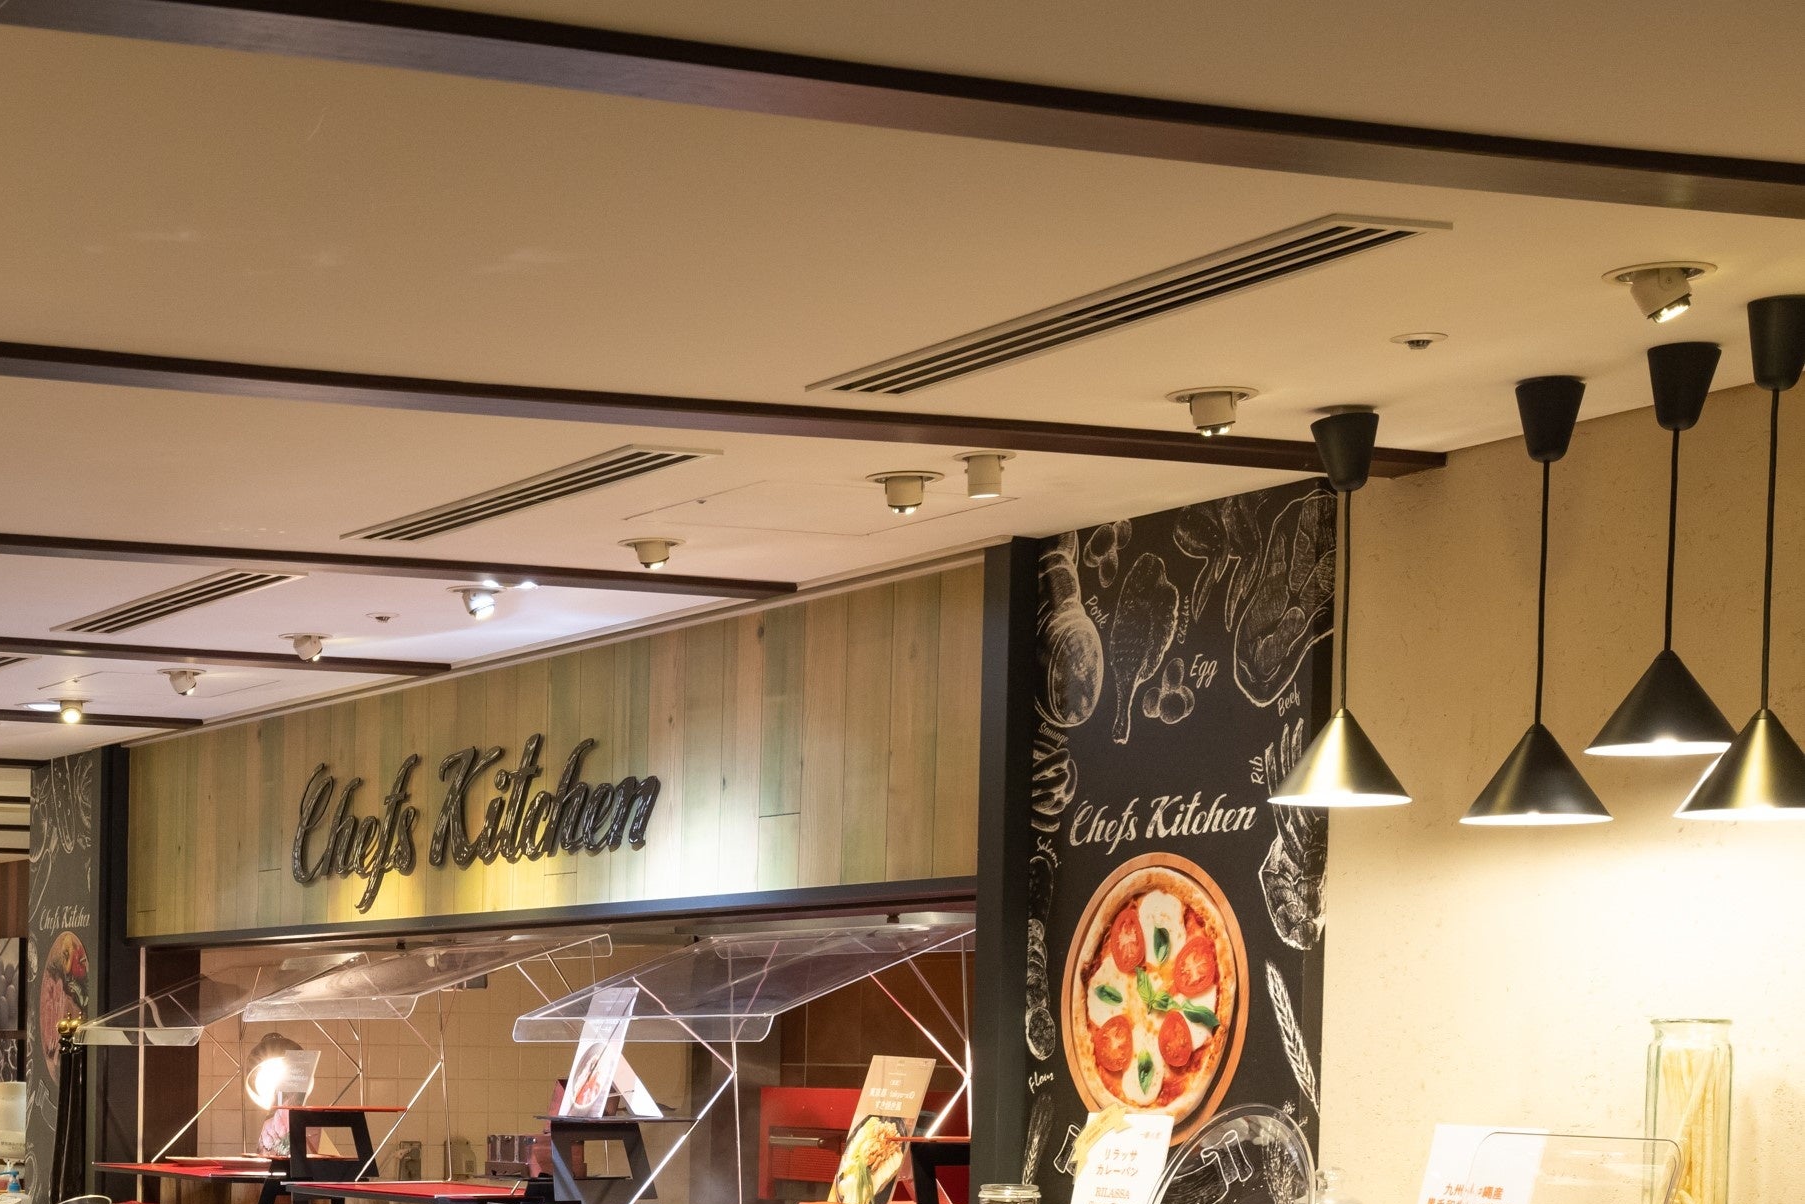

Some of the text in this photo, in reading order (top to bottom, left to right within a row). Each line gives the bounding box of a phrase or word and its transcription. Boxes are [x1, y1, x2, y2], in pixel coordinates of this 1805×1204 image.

[1085, 595, 1108, 629] Pork
[1189, 653, 1218, 688] Egg
[1277, 682, 1301, 717] Beef
[1038, 722, 1069, 748] Sausage
[1250, 756, 1265, 785] Rib
[292, 732, 661, 914] Chefs Kitchen
[1069, 790, 1258, 855] Chefs Kitchen
[1096, 1164, 1139, 1177] カレーパン
[1105, 1148, 1138, 1162] リラッサ
[1095, 1187, 1131, 1200] RILASSA
